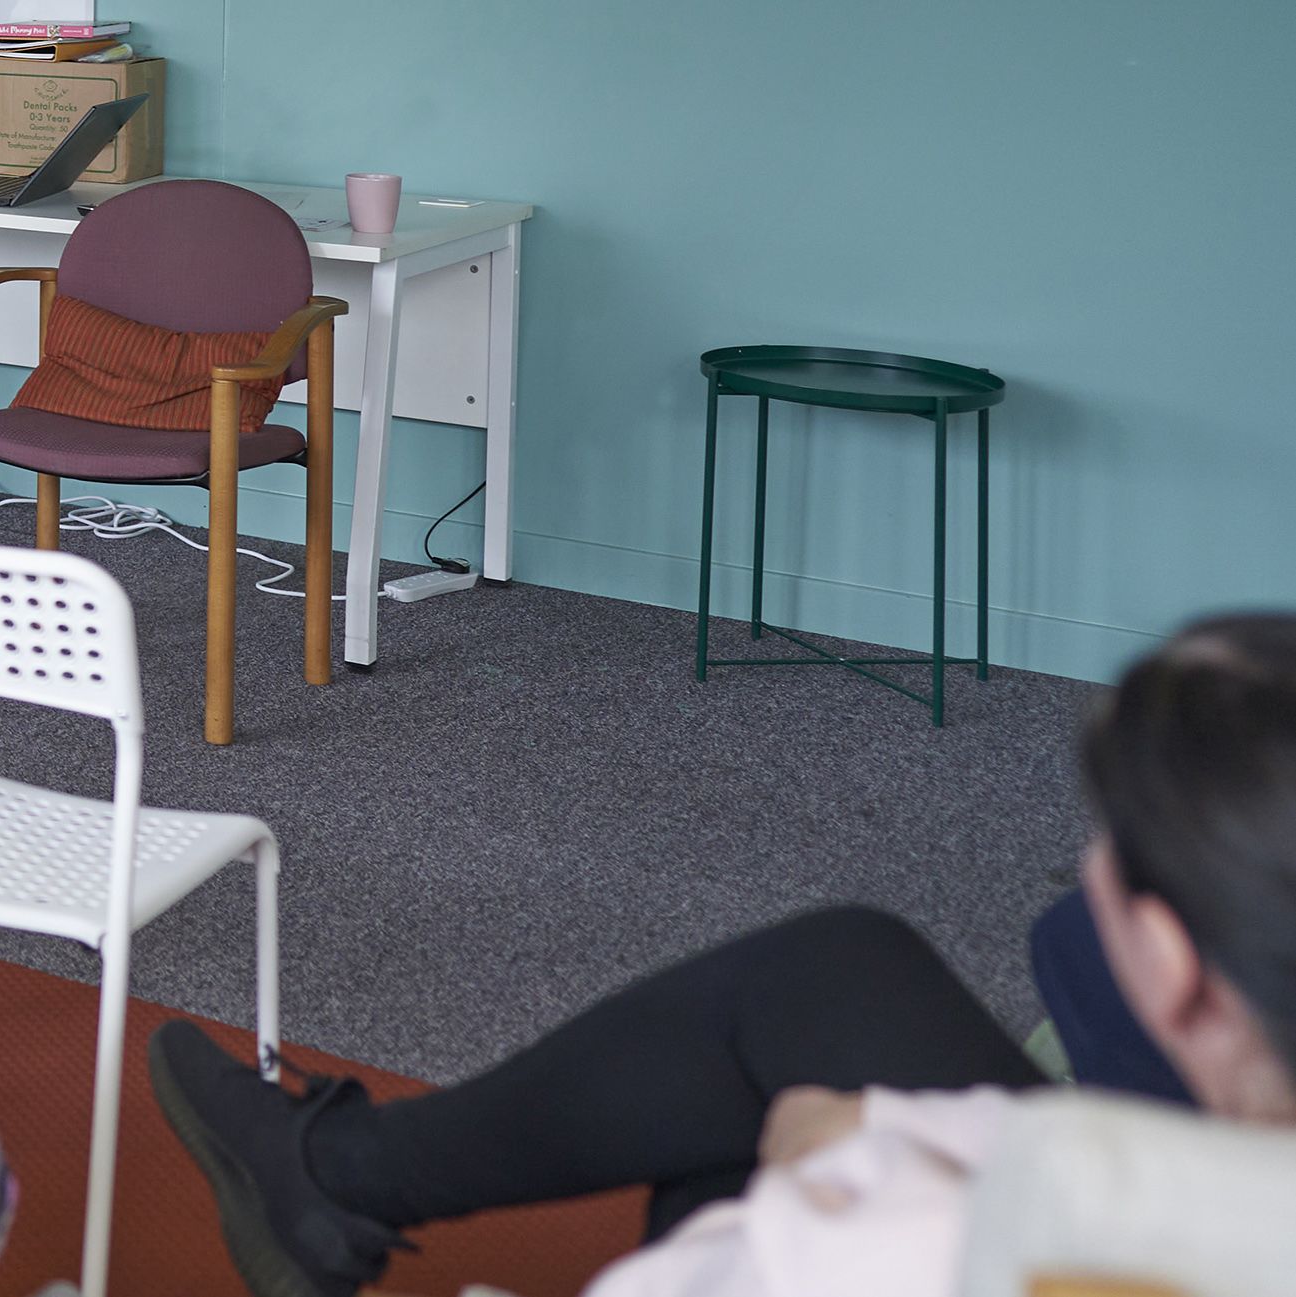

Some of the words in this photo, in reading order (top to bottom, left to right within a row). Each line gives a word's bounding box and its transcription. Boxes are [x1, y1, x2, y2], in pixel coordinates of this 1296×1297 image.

[23, 100, 51, 110] Dental
[54, 102, 78, 112] Packs
[29, 112, 43, 122] 0-3
[46, 113, 71, 123] Years
[11, 131, 18, 139] of
